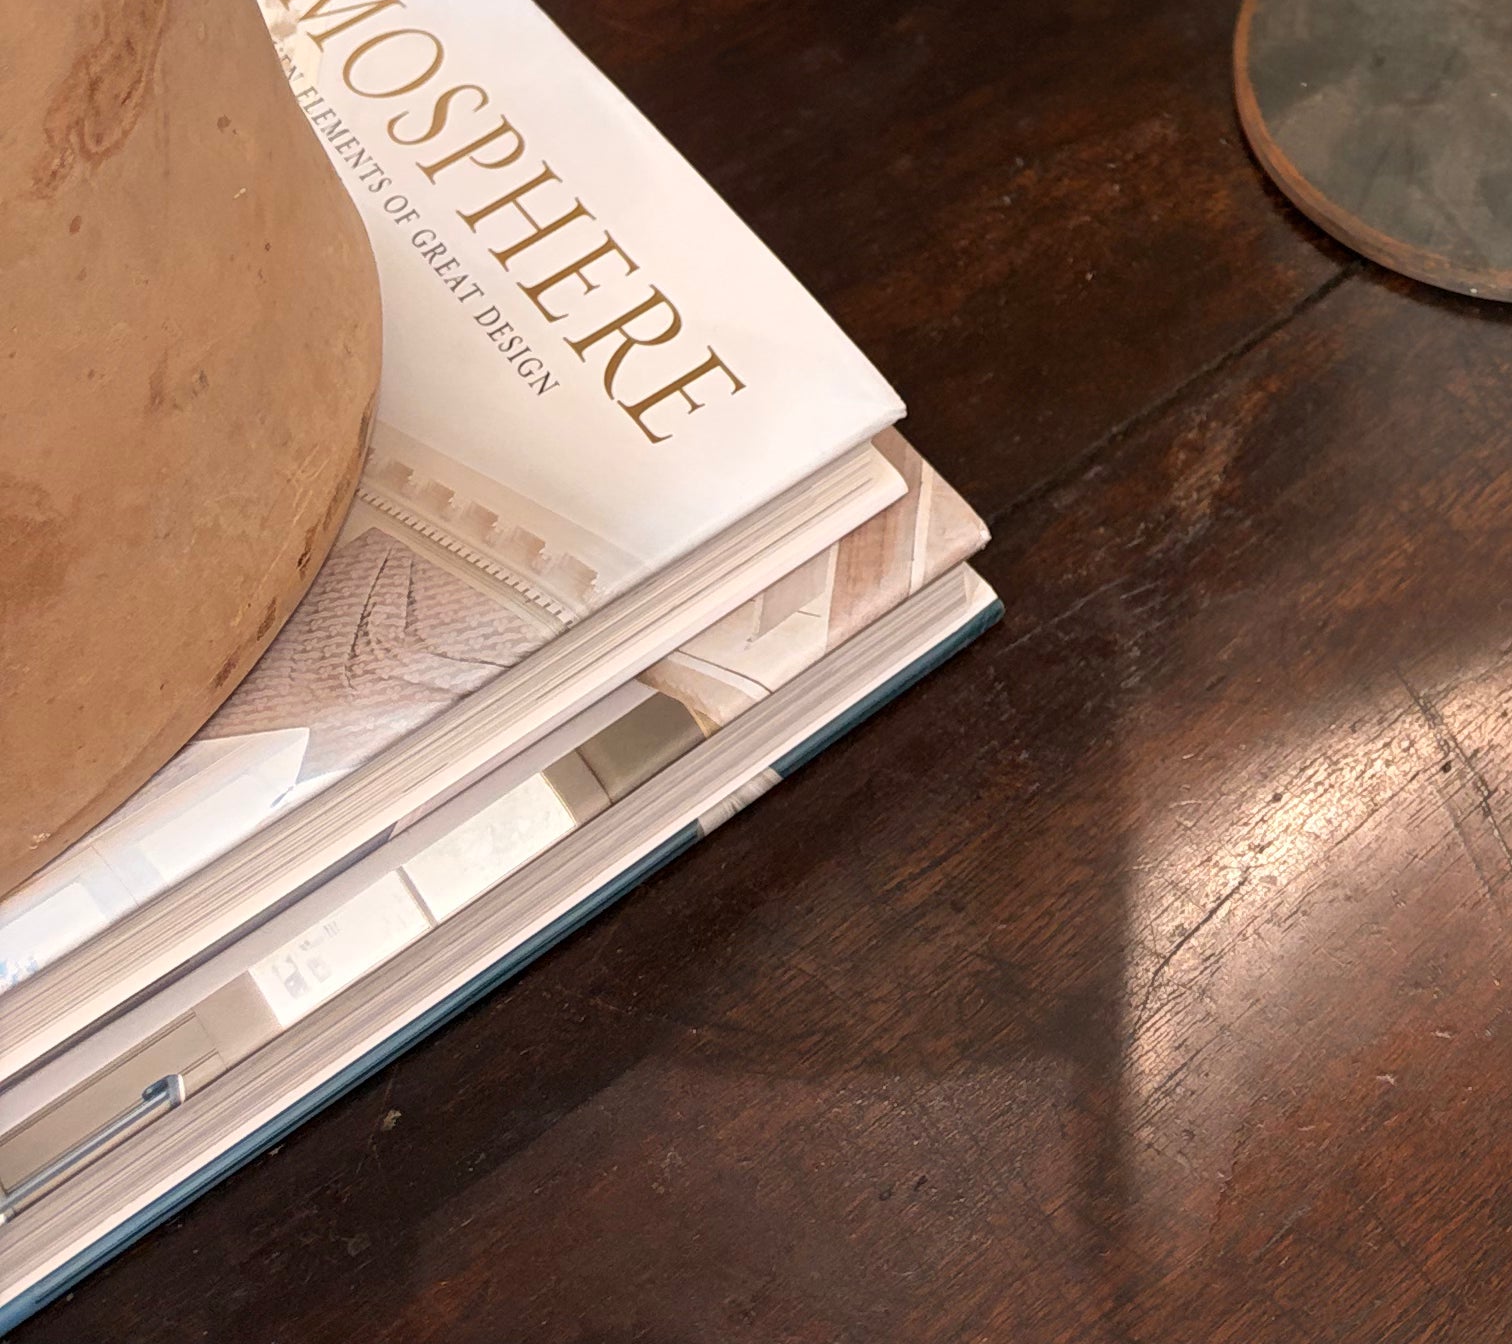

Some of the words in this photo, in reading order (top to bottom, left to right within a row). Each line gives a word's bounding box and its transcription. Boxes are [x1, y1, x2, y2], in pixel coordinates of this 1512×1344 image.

[295, 85, 393, 194] ELEMENTS
[383, 194, 421, 225] OF
[411, 228, 485, 304] GREAT
[472, 305, 561, 397] DESIGN
